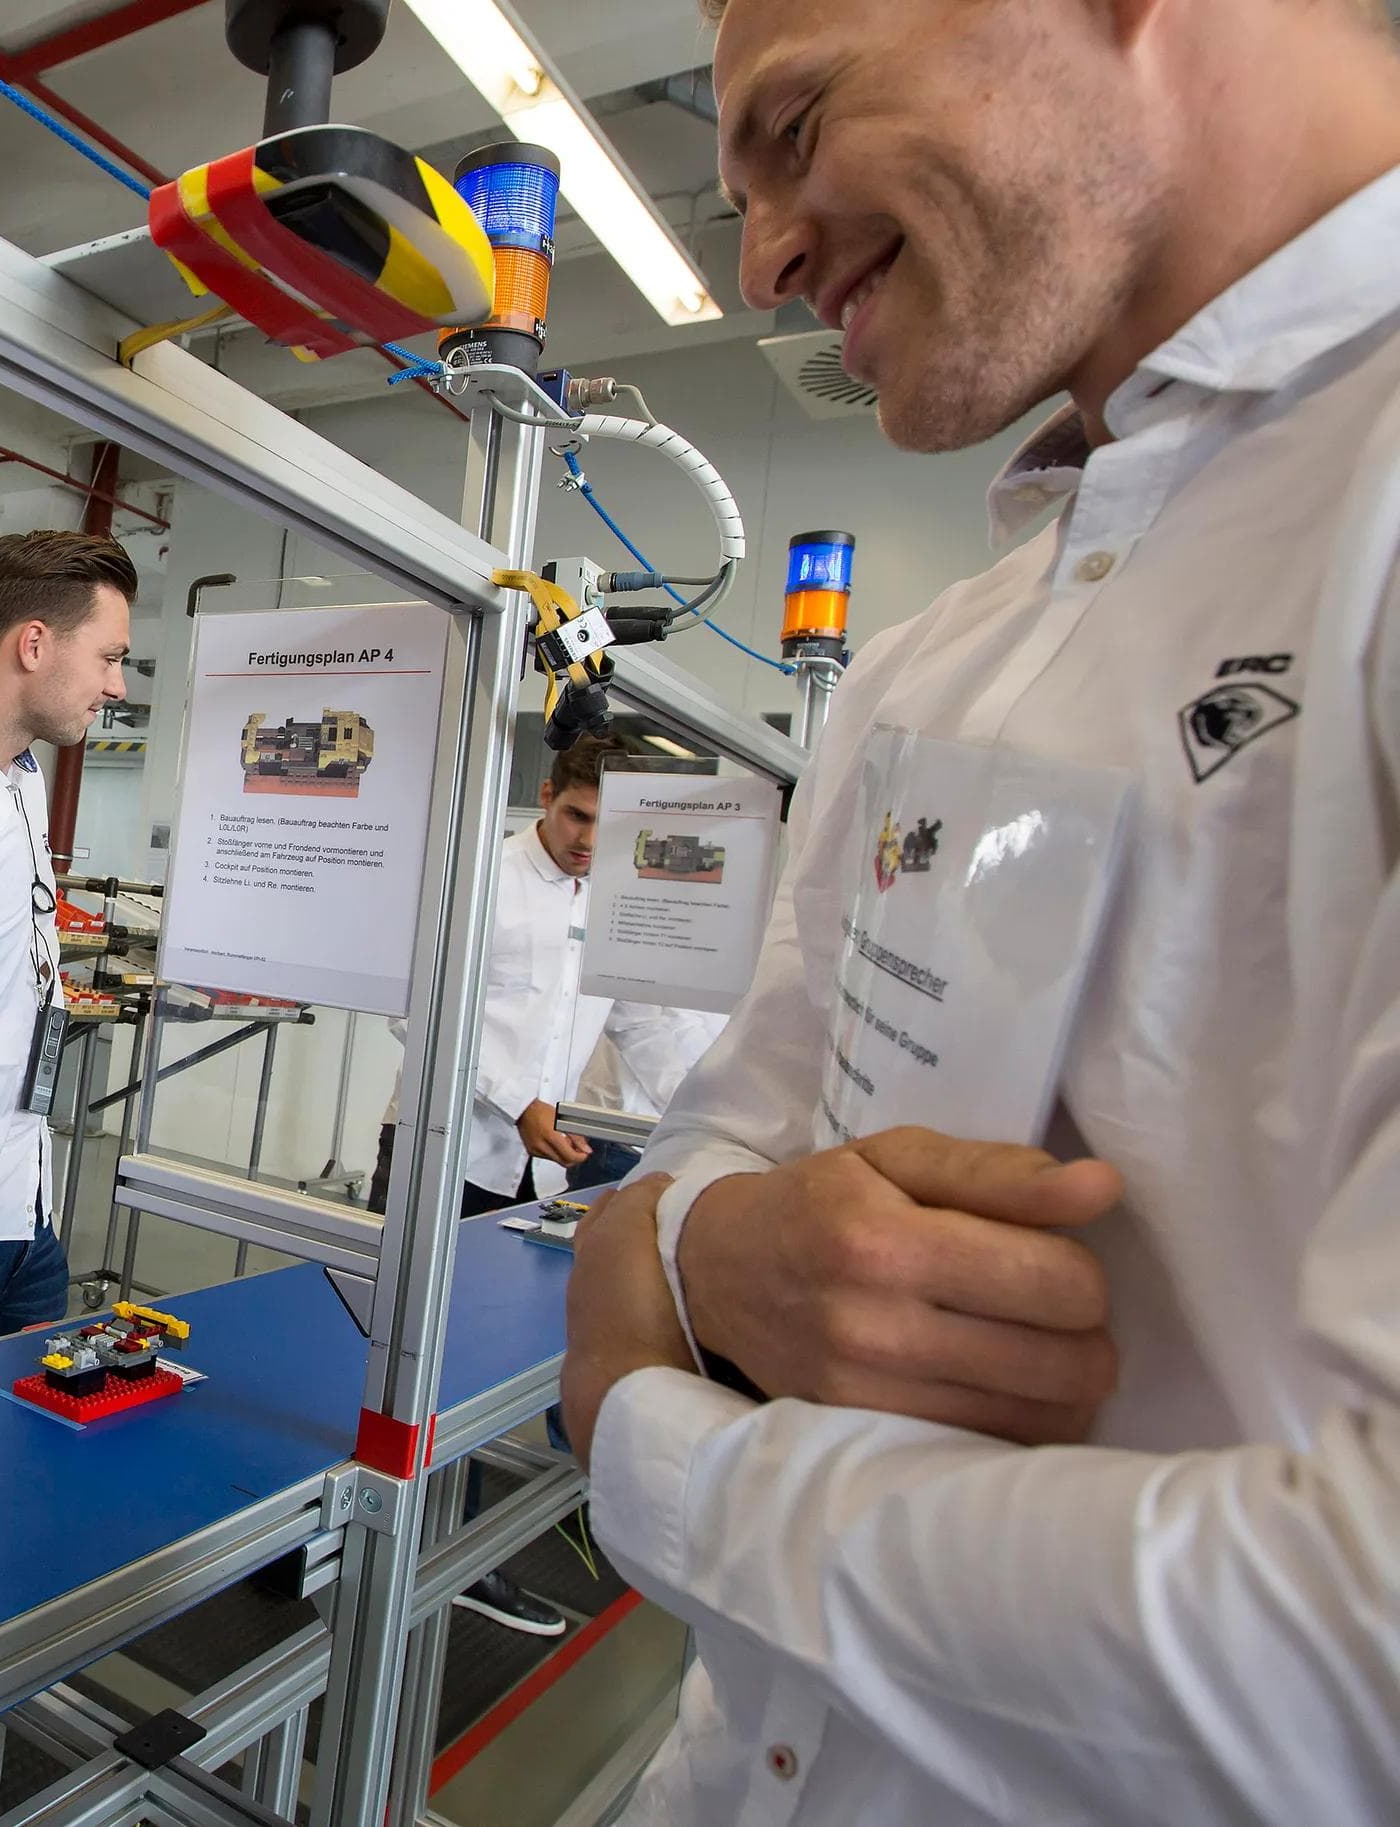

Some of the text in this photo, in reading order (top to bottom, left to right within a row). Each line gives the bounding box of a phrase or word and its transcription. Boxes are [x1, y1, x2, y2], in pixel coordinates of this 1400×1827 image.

[248, 648, 394, 667] Fertigungsplan AP 4
[1215, 652, 1291, 678] ERC
[640, 799, 741, 812] Fertigungsplan AP 3
[220, 814, 256, 824] Bauauftrag
[278, 818, 316, 828] (Bauauftrag
[318, 821, 350, 830] beachten
[352, 822, 373, 831] Farbe
[374, 824, 388, 832] und
[217, 838, 253, 849] Stoßfänger
[254, 842, 272, 850] vorne
[274, 842, 286, 850] und
[322, 845, 368, 856] vormontieren
[370, 850, 384, 858] und
[216, 848, 258, 858] anschließend
[272, 852, 304, 862] Fahrzeug
[305, 854, 316, 862] auf
[318, 856, 346, 864] Position
[347, 858, 384, 868] montieren.
[214, 862, 239, 871] Cockpit
[240, 864, 251, 872] auf
[252, 864, 278, 874] Position
[279, 868, 314, 878] montieren.
[254, 880, 266, 888] und
[280, 884, 316, 892] montieren.
[899, 1032, 939, 1067] Gruppe
